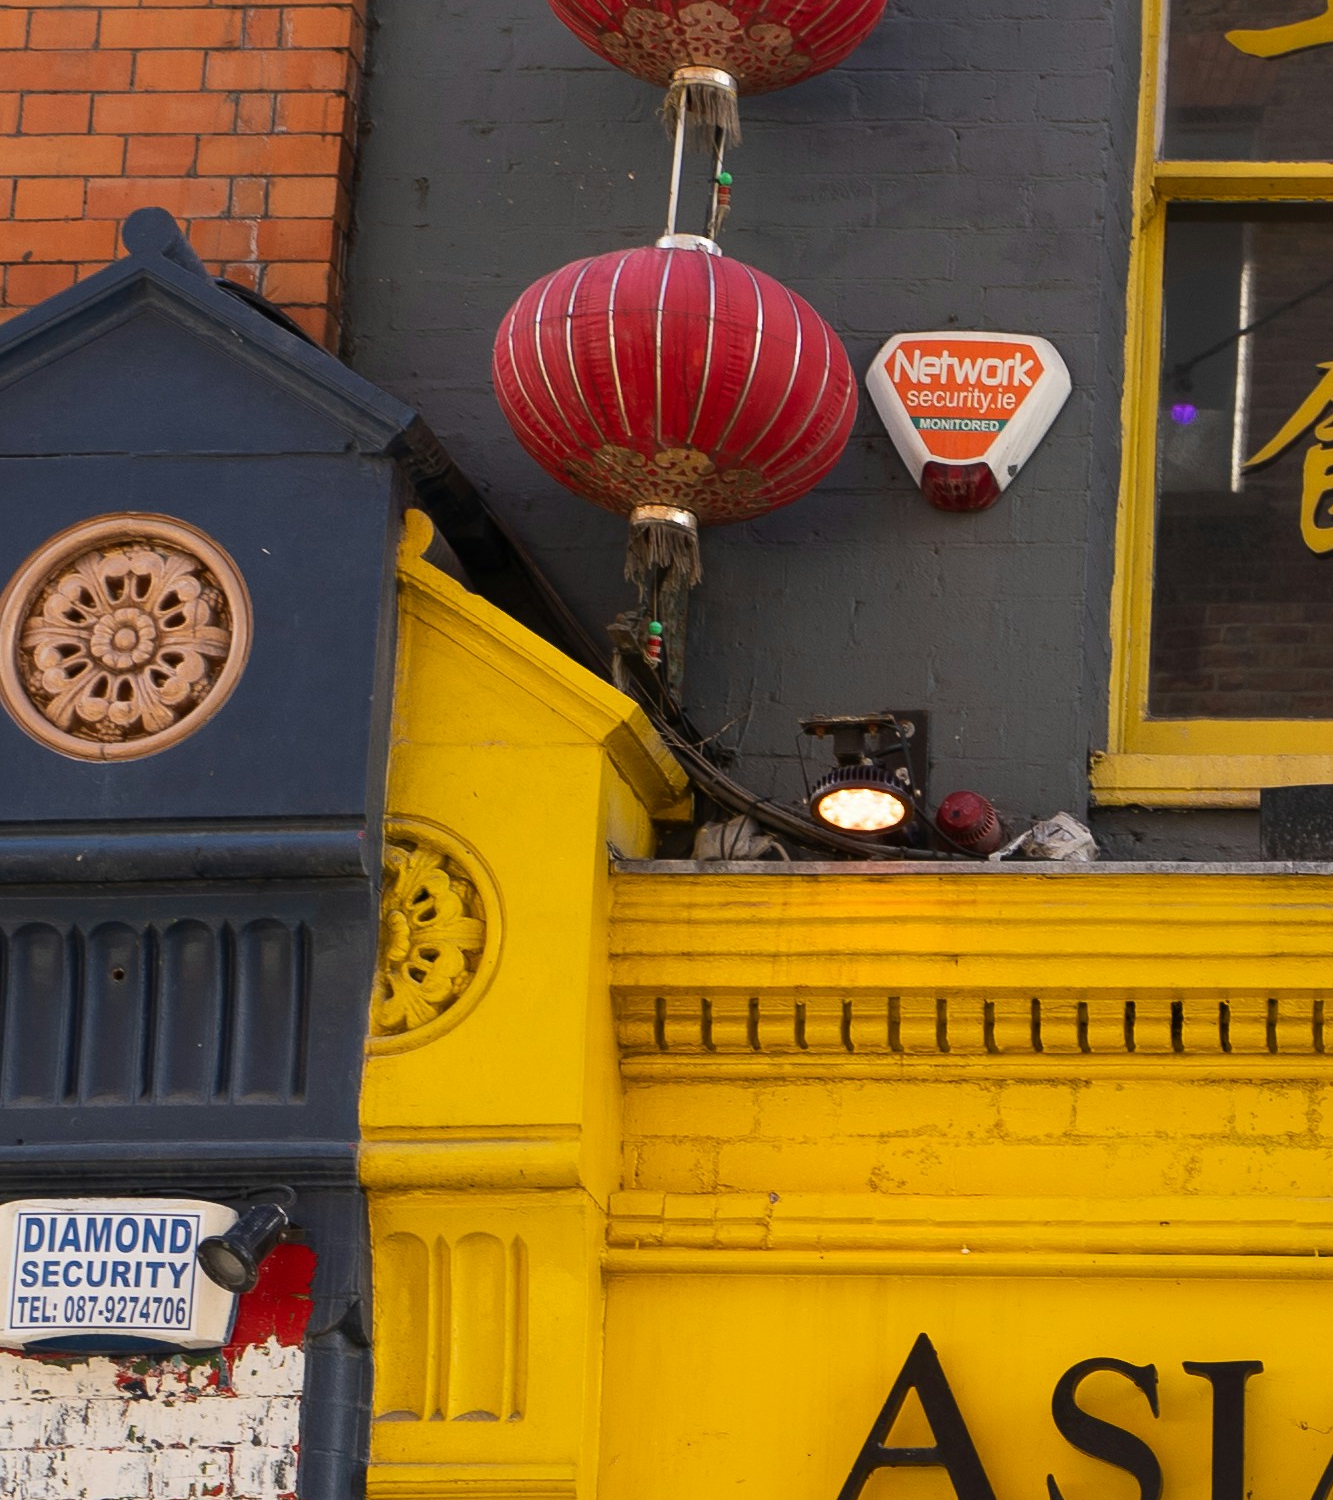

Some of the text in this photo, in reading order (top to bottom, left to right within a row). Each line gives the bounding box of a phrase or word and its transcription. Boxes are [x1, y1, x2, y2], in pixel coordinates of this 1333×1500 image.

[893, 348, 1034, 388] Network
[906, 387, 1017, 414] security.ie
[919, 418, 999, 432] MONITORED
[23, 1216, 193, 1255] DIAMOND
[20, 1260, 190, 1289] SECURITY
[17, 1295, 187, 1325] TEL: 087-9274706
